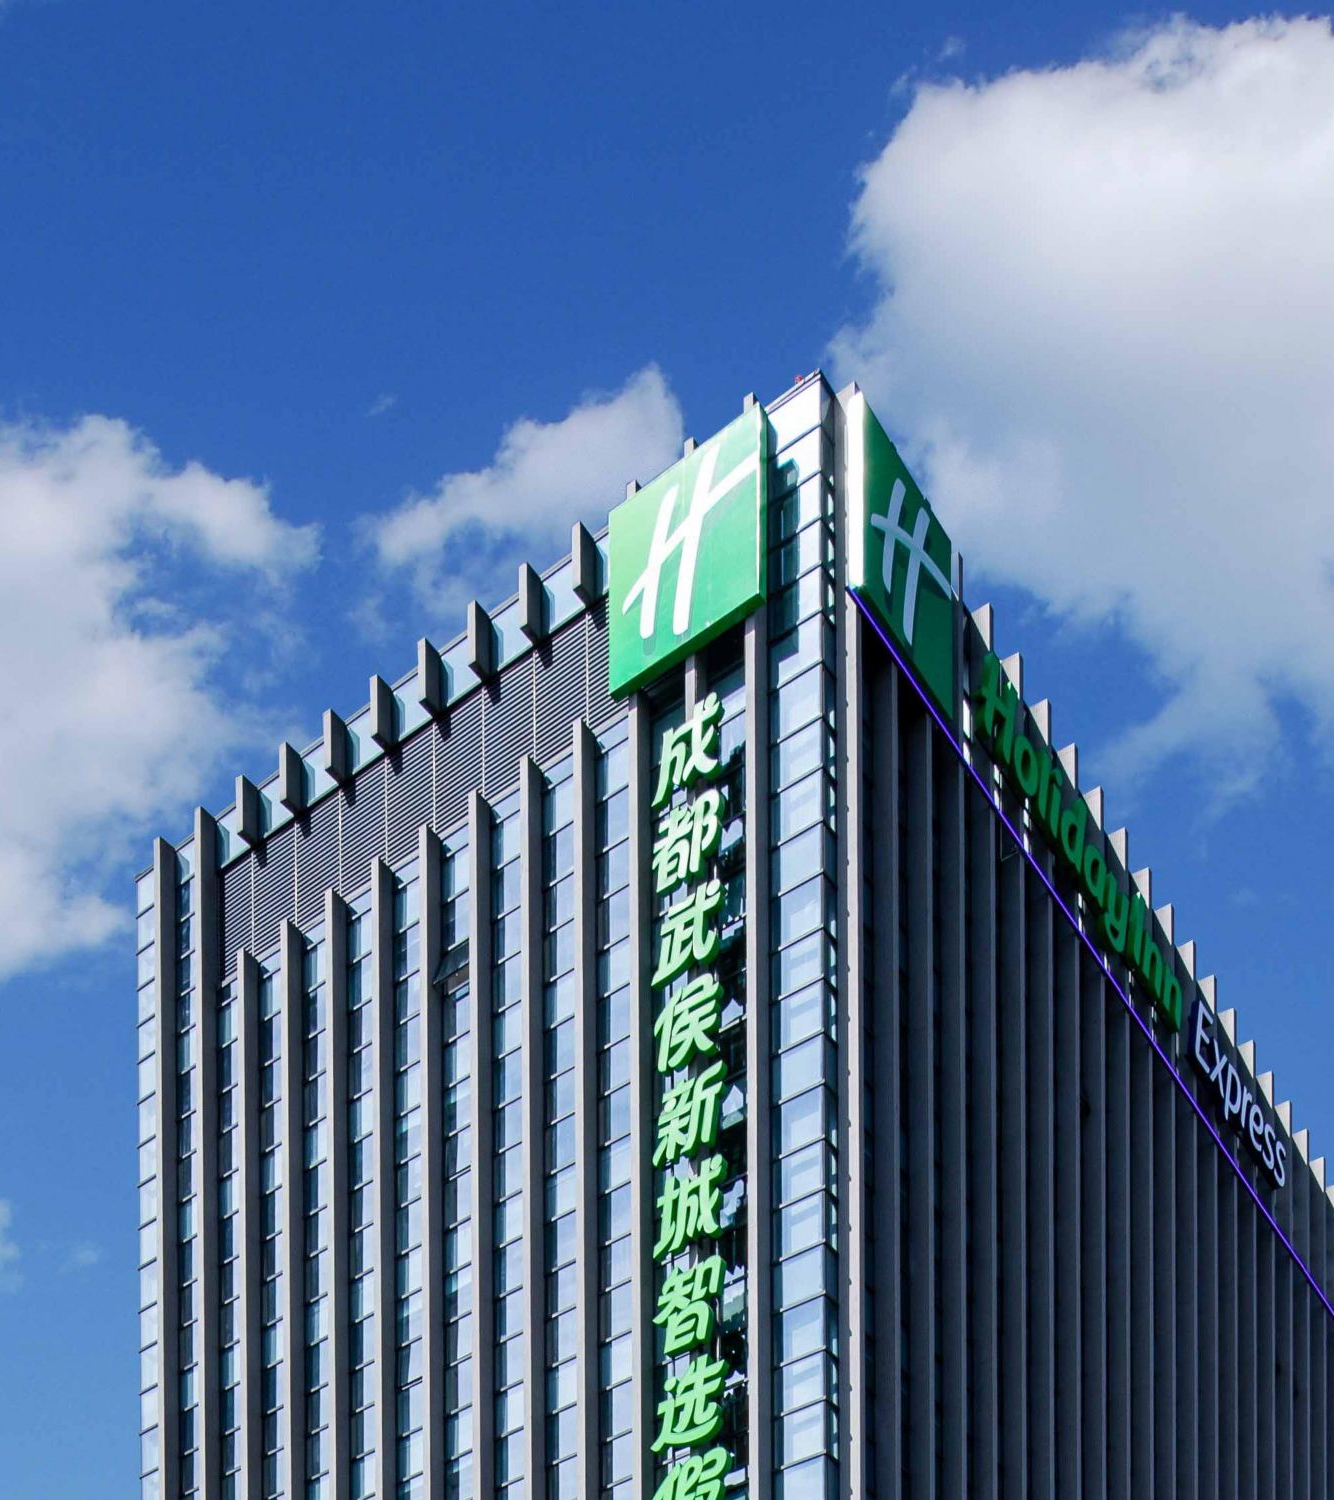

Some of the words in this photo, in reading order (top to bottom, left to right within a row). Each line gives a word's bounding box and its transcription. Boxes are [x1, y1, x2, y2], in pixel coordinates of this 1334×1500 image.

[974, 652, 1129, 954] Holiday
[1126, 893, 1183, 1033] Inn
[1192, 1000, 1286, 1188] Express
